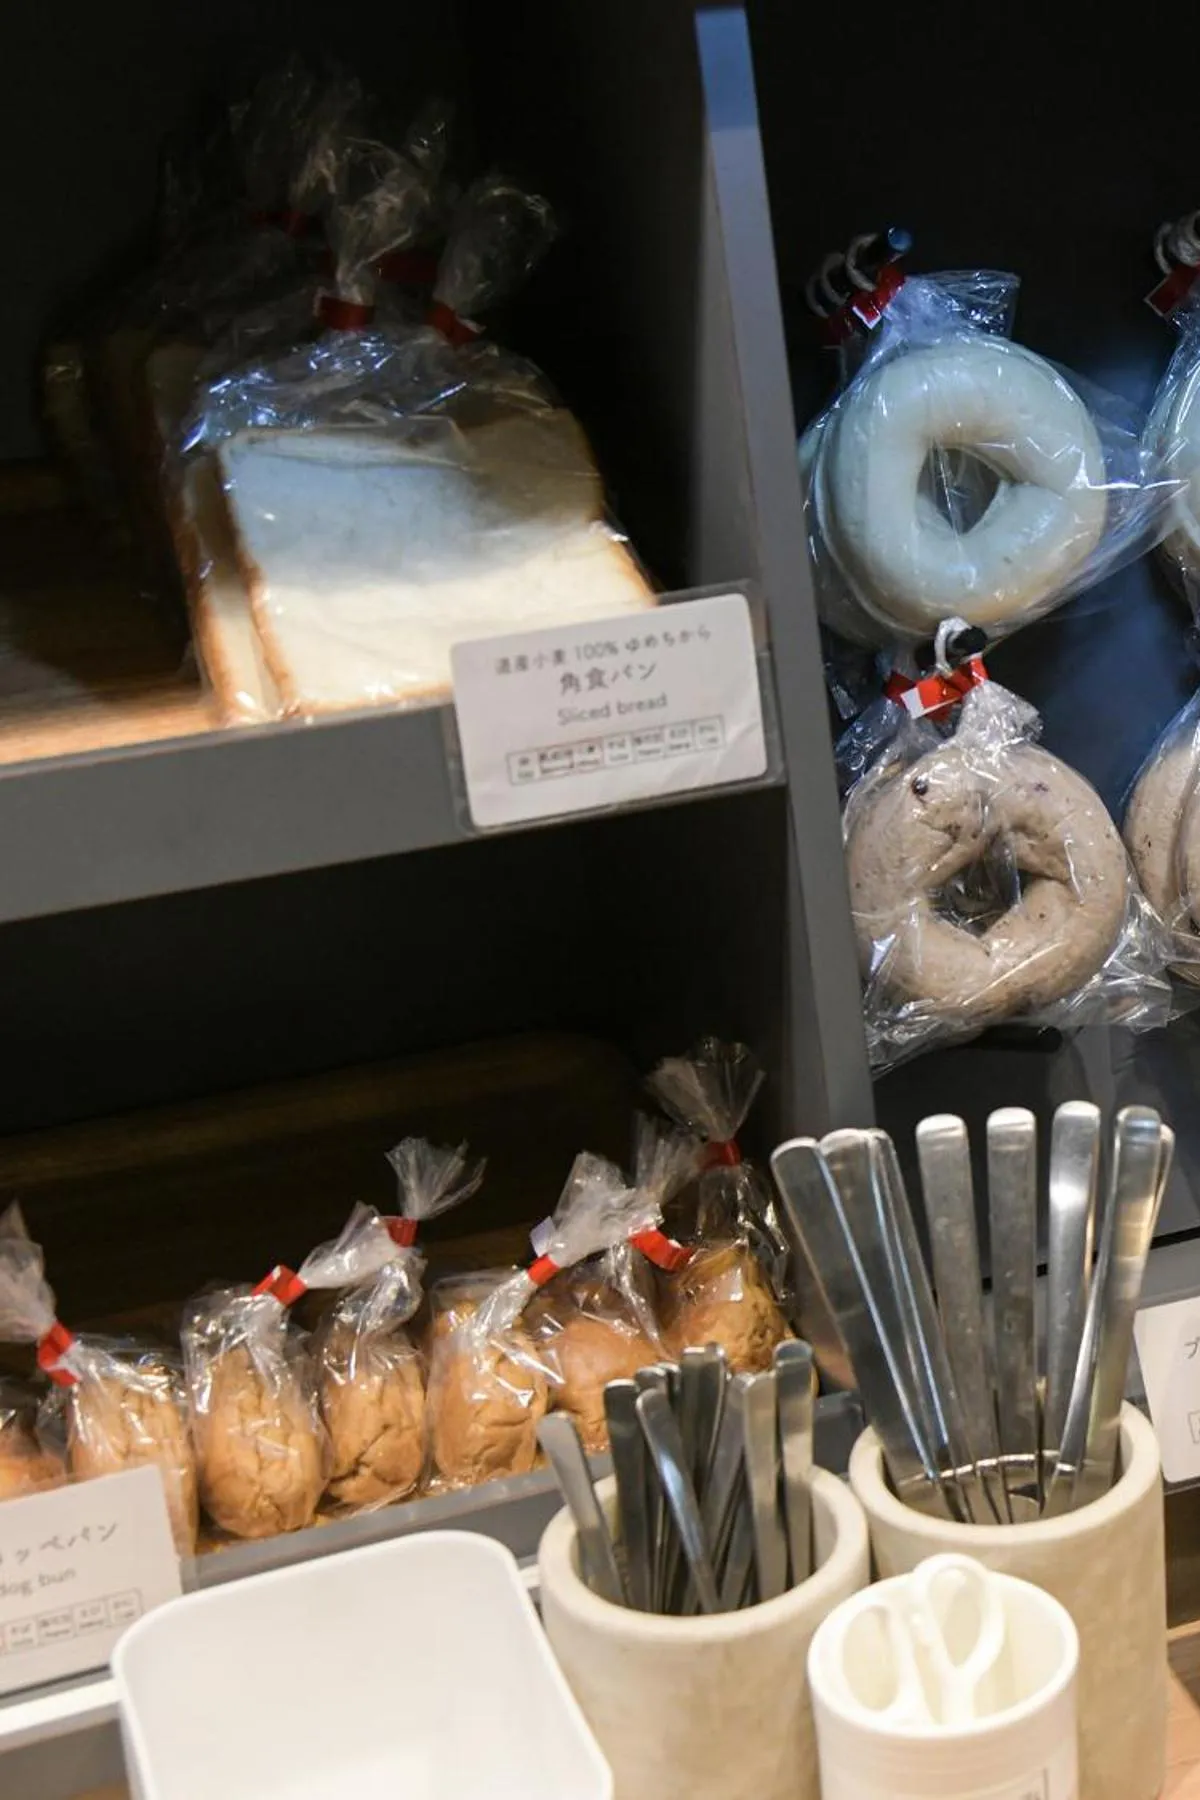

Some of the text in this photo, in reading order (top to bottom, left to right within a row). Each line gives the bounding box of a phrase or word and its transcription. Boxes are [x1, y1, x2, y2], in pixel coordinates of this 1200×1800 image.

[559, 662, 657, 696] 角食パン
[557, 693, 668, 726] Sliced bread
